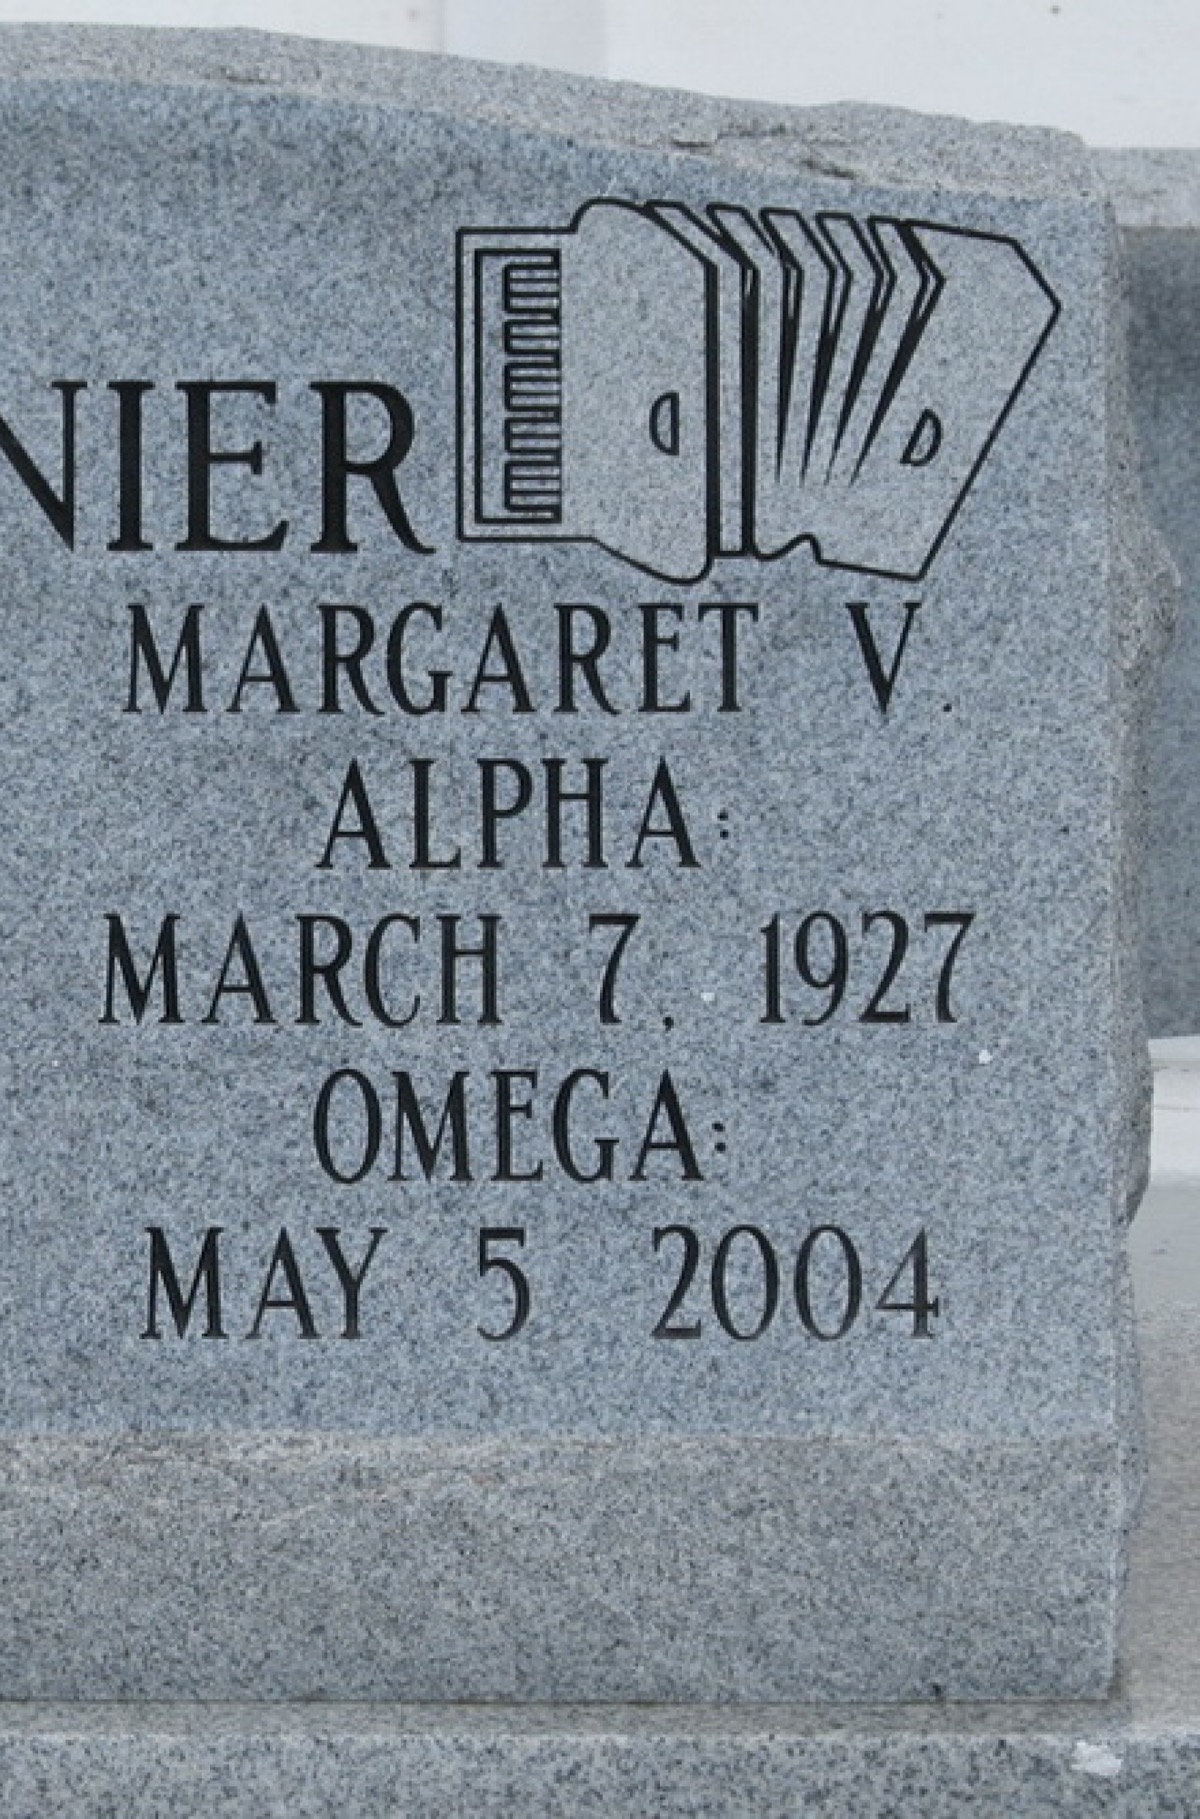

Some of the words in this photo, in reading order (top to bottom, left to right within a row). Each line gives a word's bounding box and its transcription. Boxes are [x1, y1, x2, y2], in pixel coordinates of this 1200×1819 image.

[123, 601, 760, 717] MARGARET
[845, 601, 956, 715] V.
[315, 757, 732, 870] ALPHA:
[98, 912, 502, 1028] MARCH
[588, 912, 676, 1032] 7,
[759, 910, 975, 1026] 1927
[312, 1067, 729, 1186] OMEGA:
[139, 1225, 387, 1341] MAY
[475, 1224, 532, 1342] 5
[652, 1224, 942, 1342] 2004
